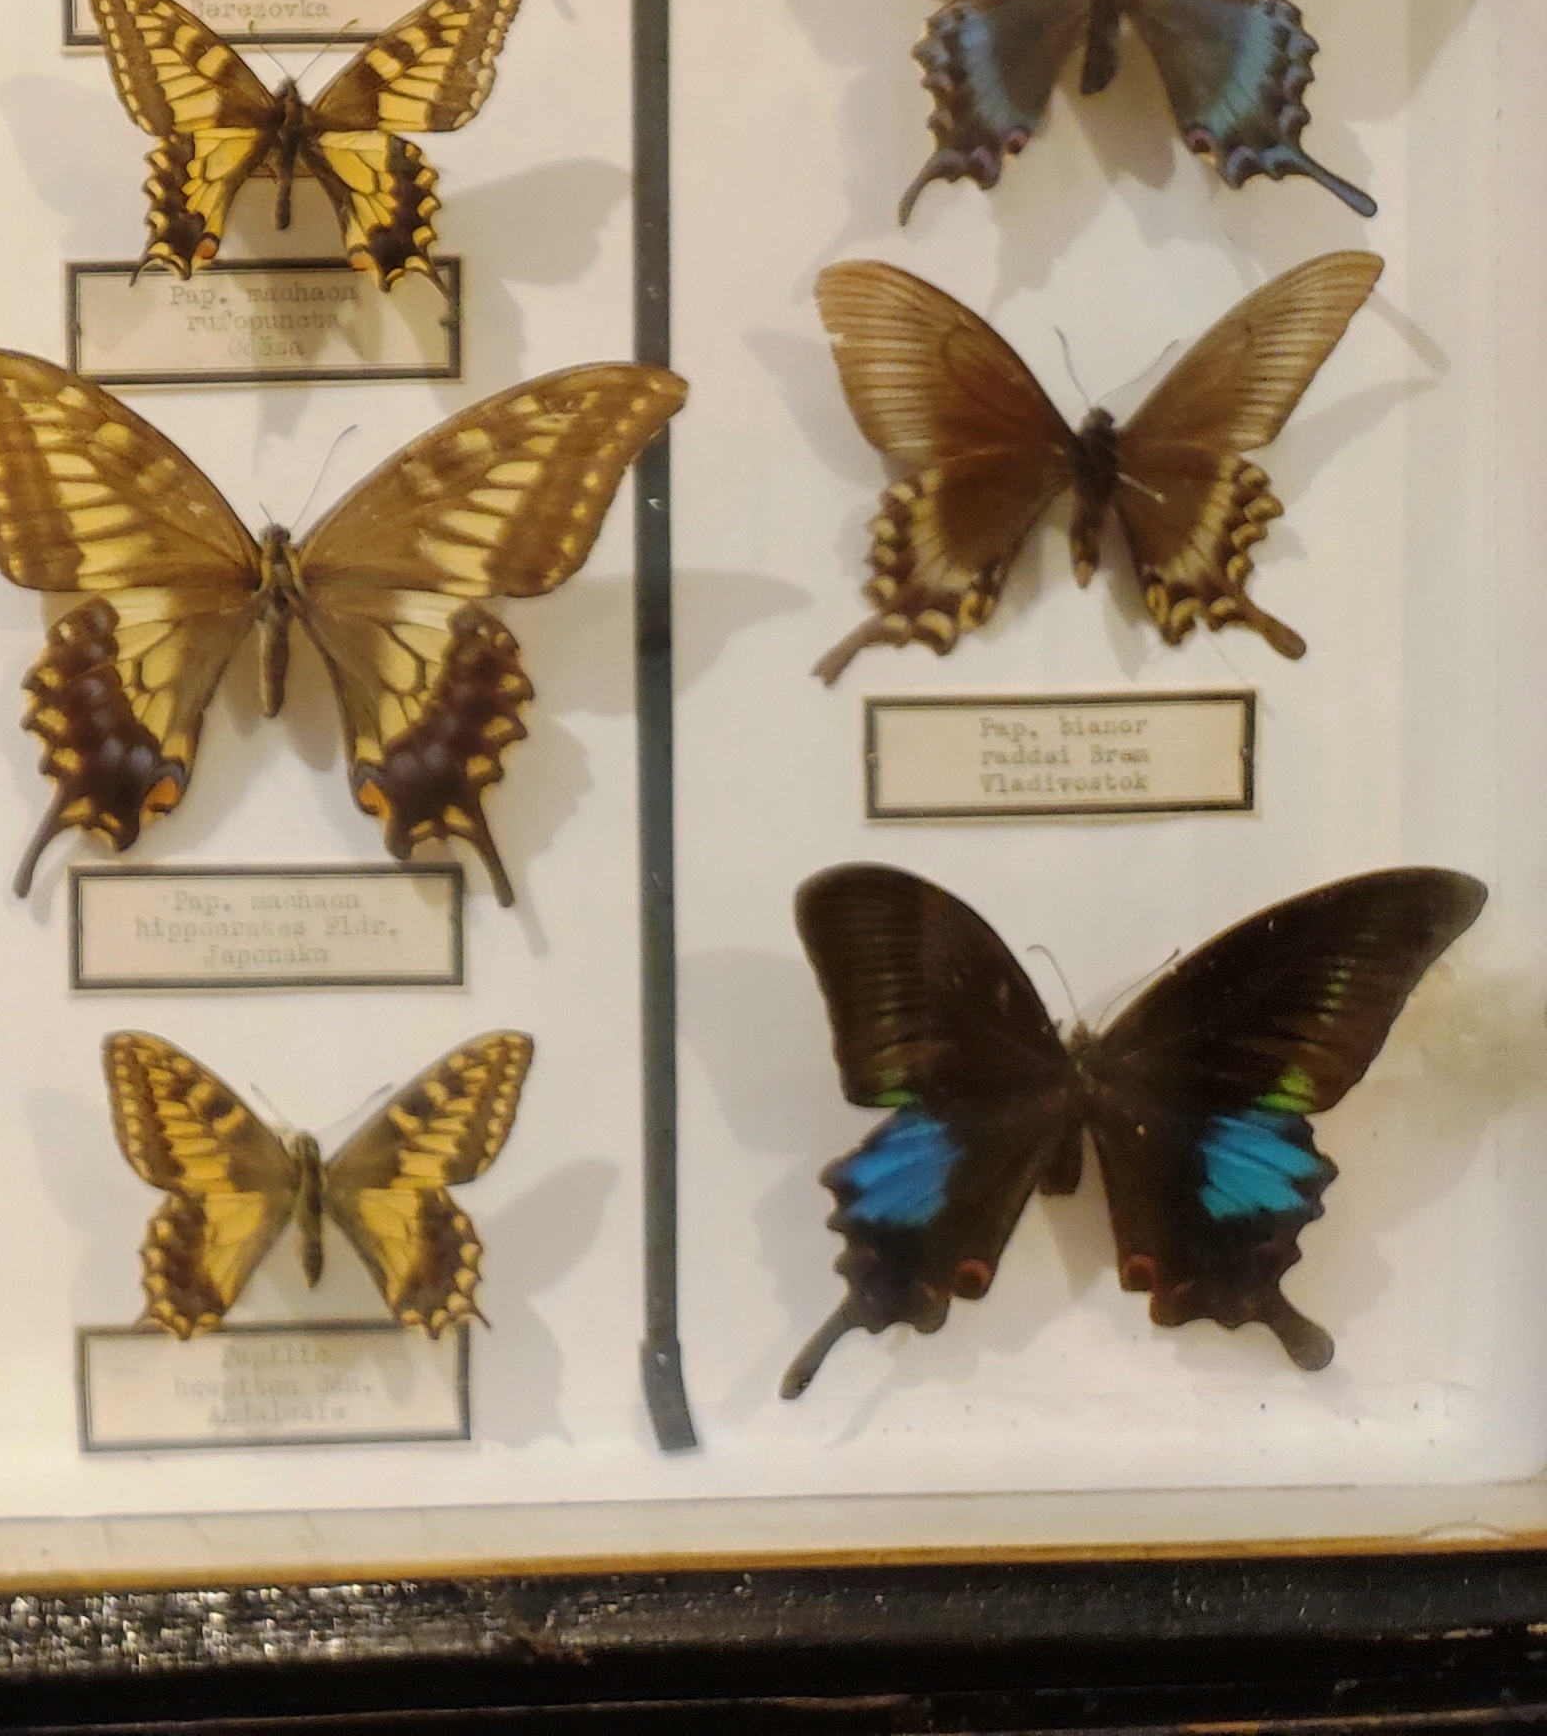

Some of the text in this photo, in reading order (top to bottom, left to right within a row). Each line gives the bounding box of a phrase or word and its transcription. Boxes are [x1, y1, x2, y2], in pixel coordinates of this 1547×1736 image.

[169, 279, 359, 311] Pap. machaon
[979, 713, 1148, 742] Pap. bianor
[979, 769, 1148, 797] Vladivostok
[173, 887, 360, 916] Pap. machaon
